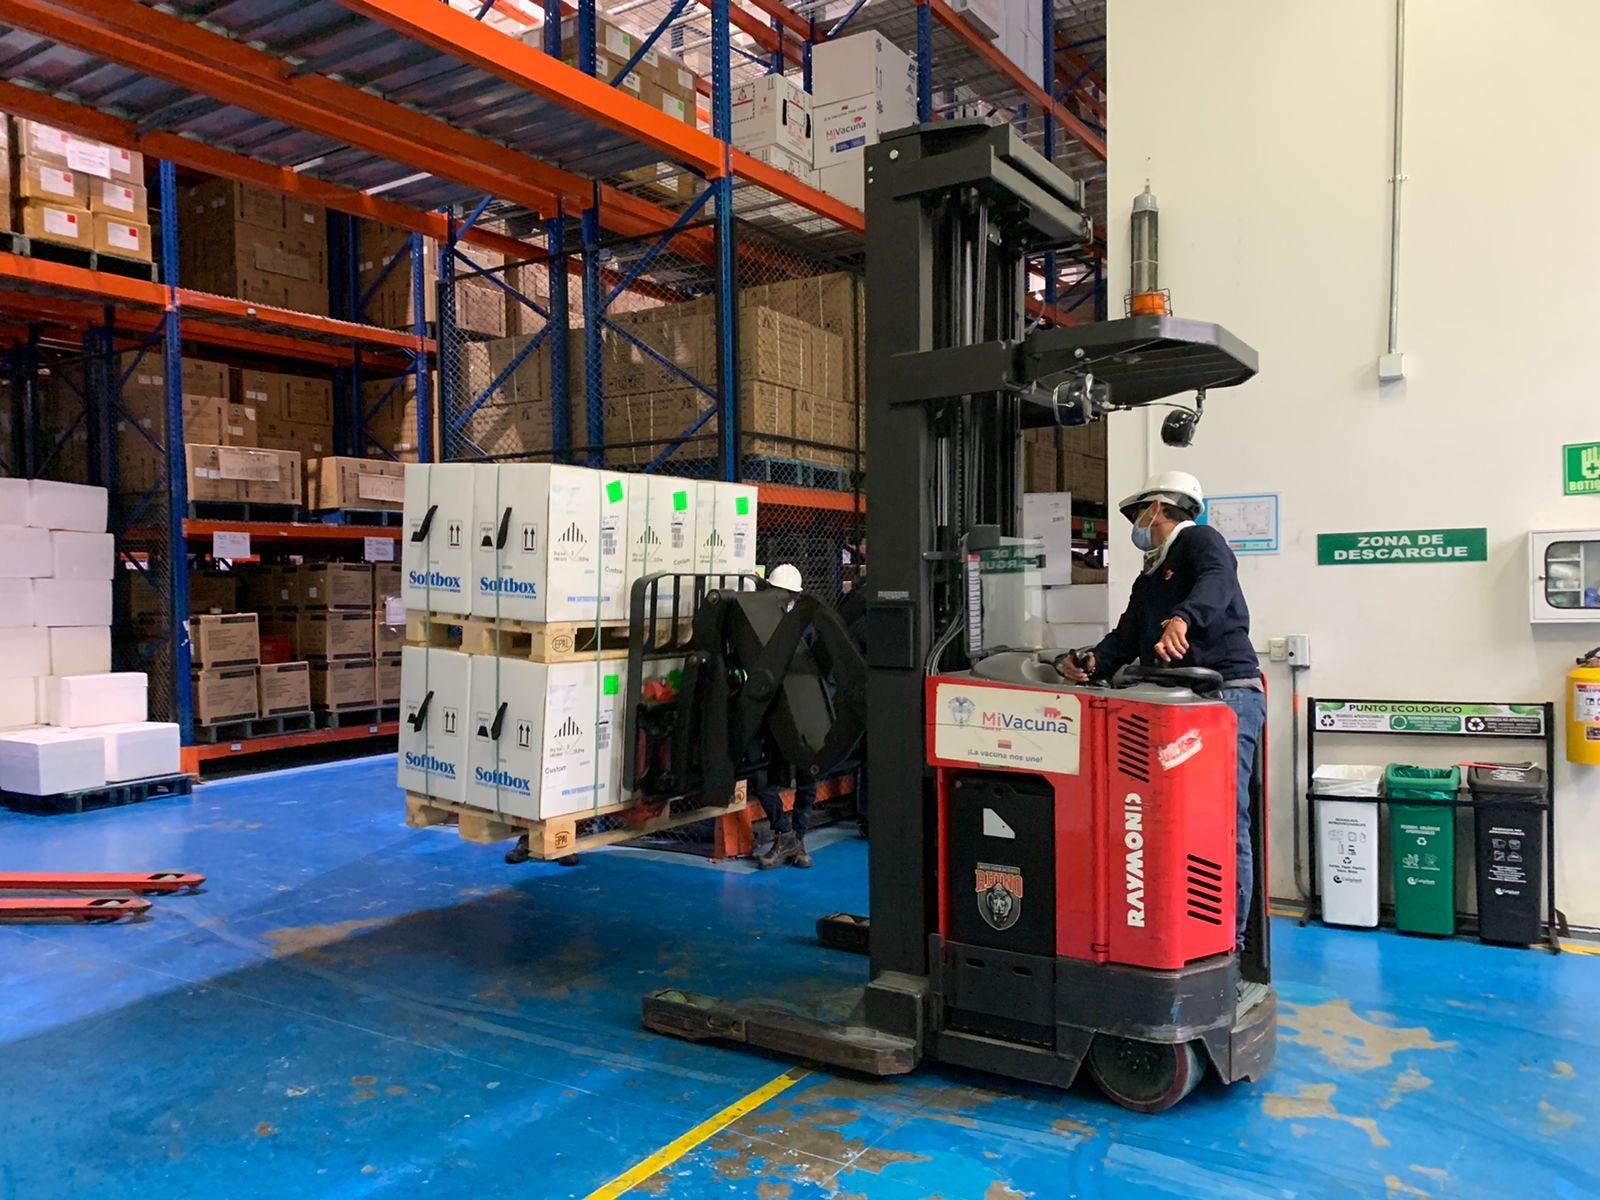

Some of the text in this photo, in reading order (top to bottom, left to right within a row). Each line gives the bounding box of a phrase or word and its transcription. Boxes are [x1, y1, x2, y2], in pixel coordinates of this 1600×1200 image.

[826, 122, 866, 138] MiVacuna
[1358, 534, 1444, 547] ZONA DE
[1334, 546, 1469, 560] DESCARGUE
[409, 571, 461, 588] Softbox
[480, 577, 536, 594] Softbox
[1349, 704, 1463, 714] PUNTO ECOLOGICO
[982, 711, 1068, 734] MiVacuna
[405, 751, 456, 775] Softbox
[967, 749, 1043, 763] ¡La vacuna nos une!
[475, 766, 530, 791] Softbox
[1124, 792, 1145, 927] RAYMOND
